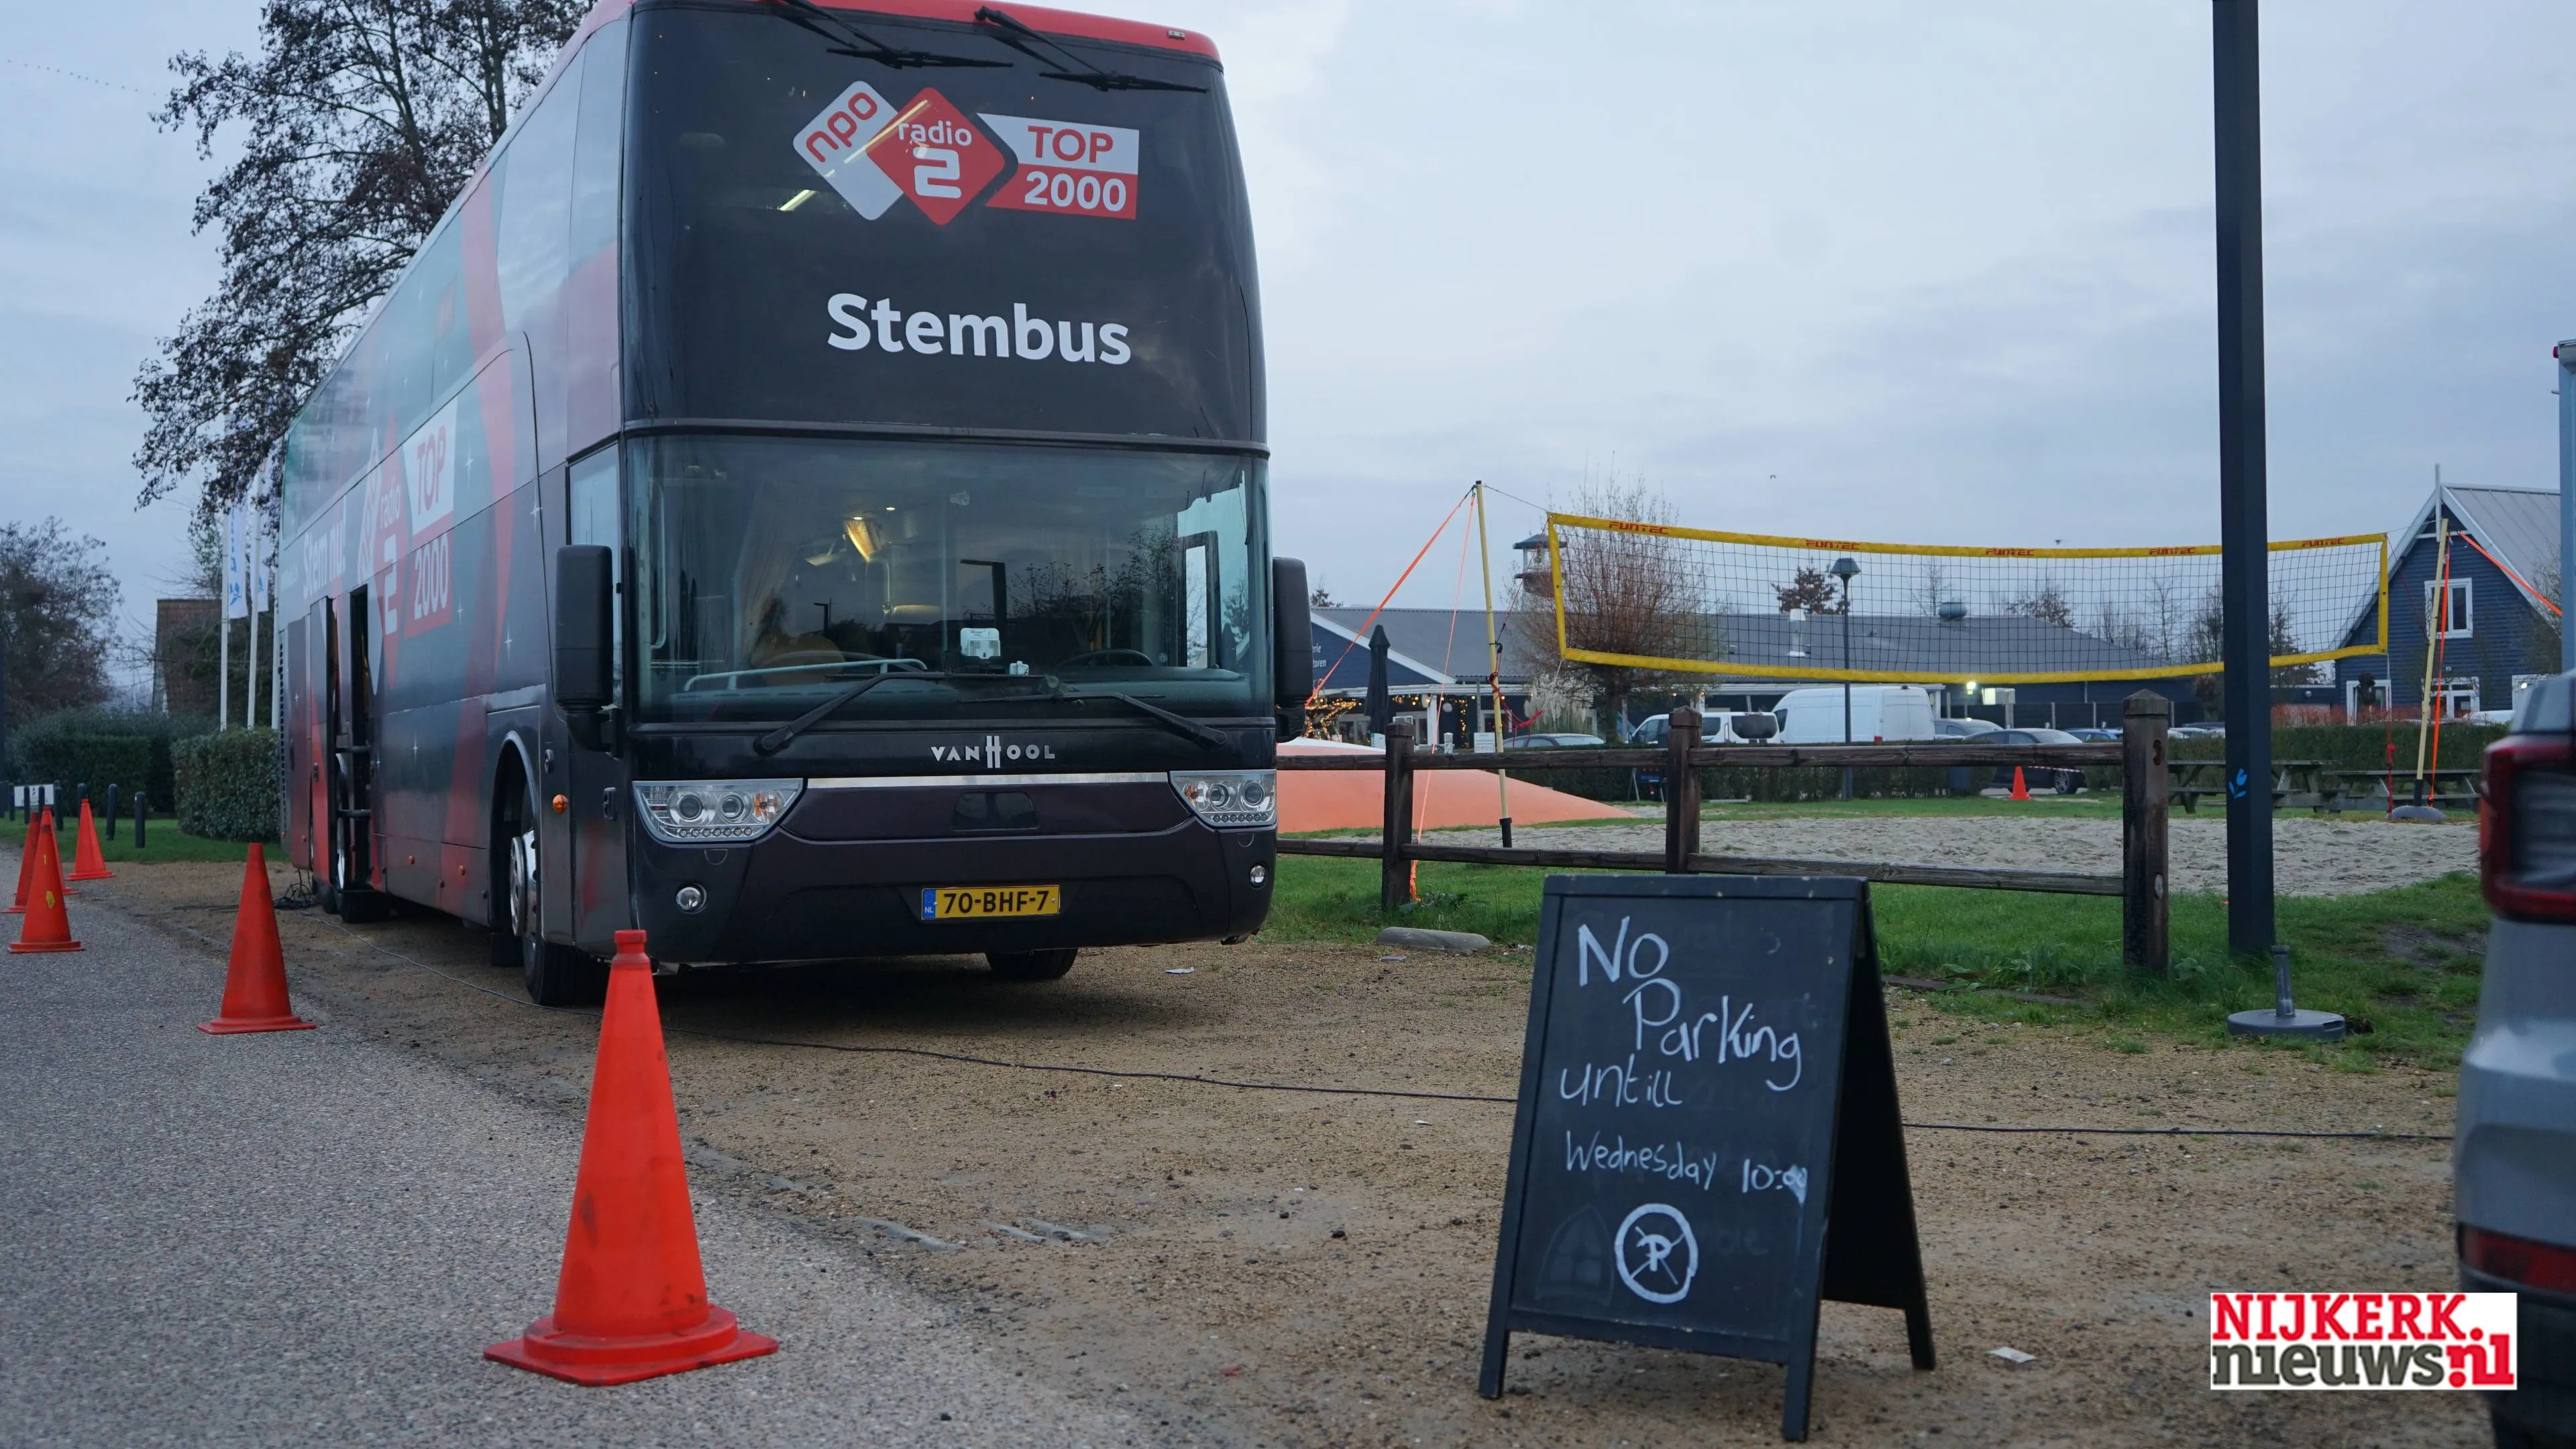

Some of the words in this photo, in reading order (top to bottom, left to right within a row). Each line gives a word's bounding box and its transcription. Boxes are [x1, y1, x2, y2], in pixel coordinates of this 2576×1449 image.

[806, 91, 878, 163] npo
[898, 121, 972, 146] radio
[1027, 125, 1114, 163] TOP
[913, 146, 962, 199] 2
[1024, 170, 1126, 212] 2000
[826, 292, 1132, 365] Stembus
[416, 425, 446, 517] TOP
[414, 532, 449, 620] 2000
[943, 890, 1049, 914] 70-BHF-7
[1566, 1130, 1717, 1190] Wednesday
